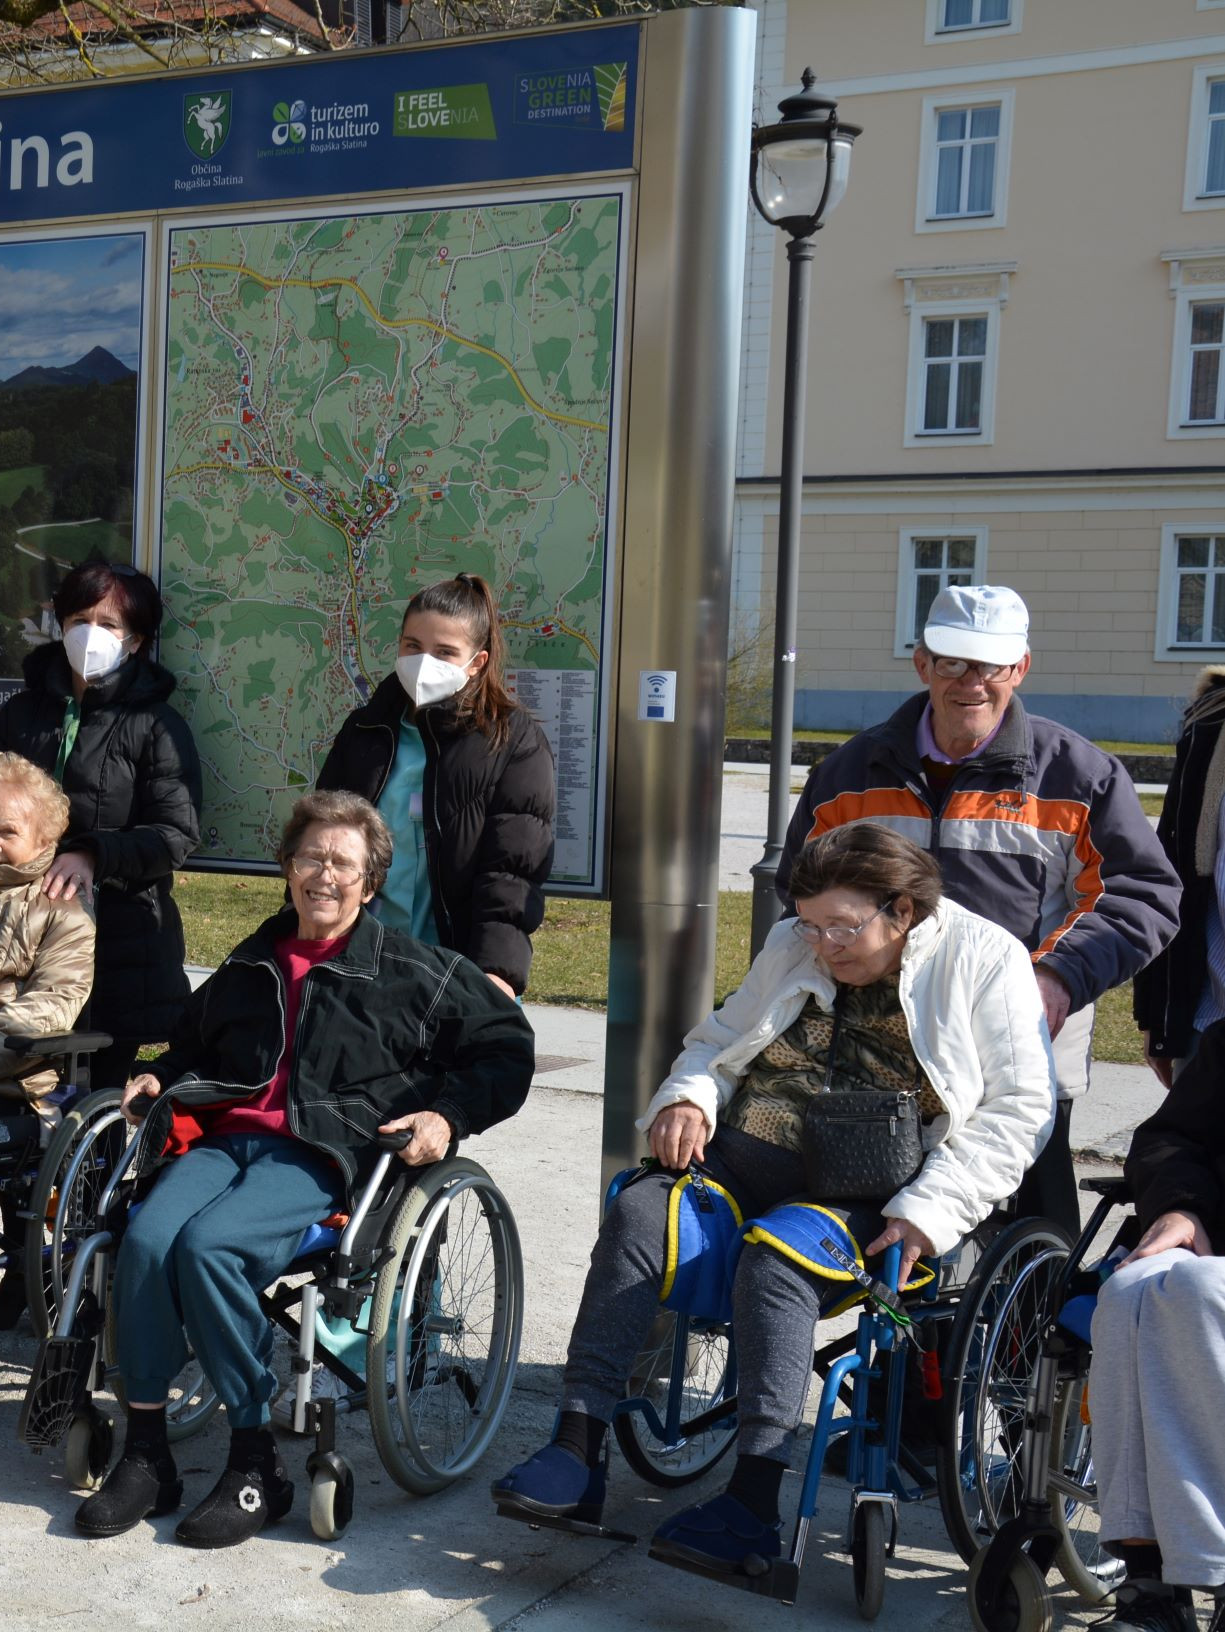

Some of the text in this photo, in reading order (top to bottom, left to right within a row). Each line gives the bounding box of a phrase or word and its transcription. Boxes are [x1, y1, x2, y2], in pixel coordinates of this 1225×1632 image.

[520, 72, 592, 92] SLOVENIA
[398, 92, 447, 112] I FEEL
[528, 88, 591, 109] GREEN
[310, 102, 369, 122] turizem
[528, 104, 591, 120] DESTINATION
[311, 120, 380, 141] in kulturo
[310, 139, 368, 154] Rogaška Slatina
[191, 163, 222, 175] Občina
[174, 174, 244, 192] Rogaška Slatina
